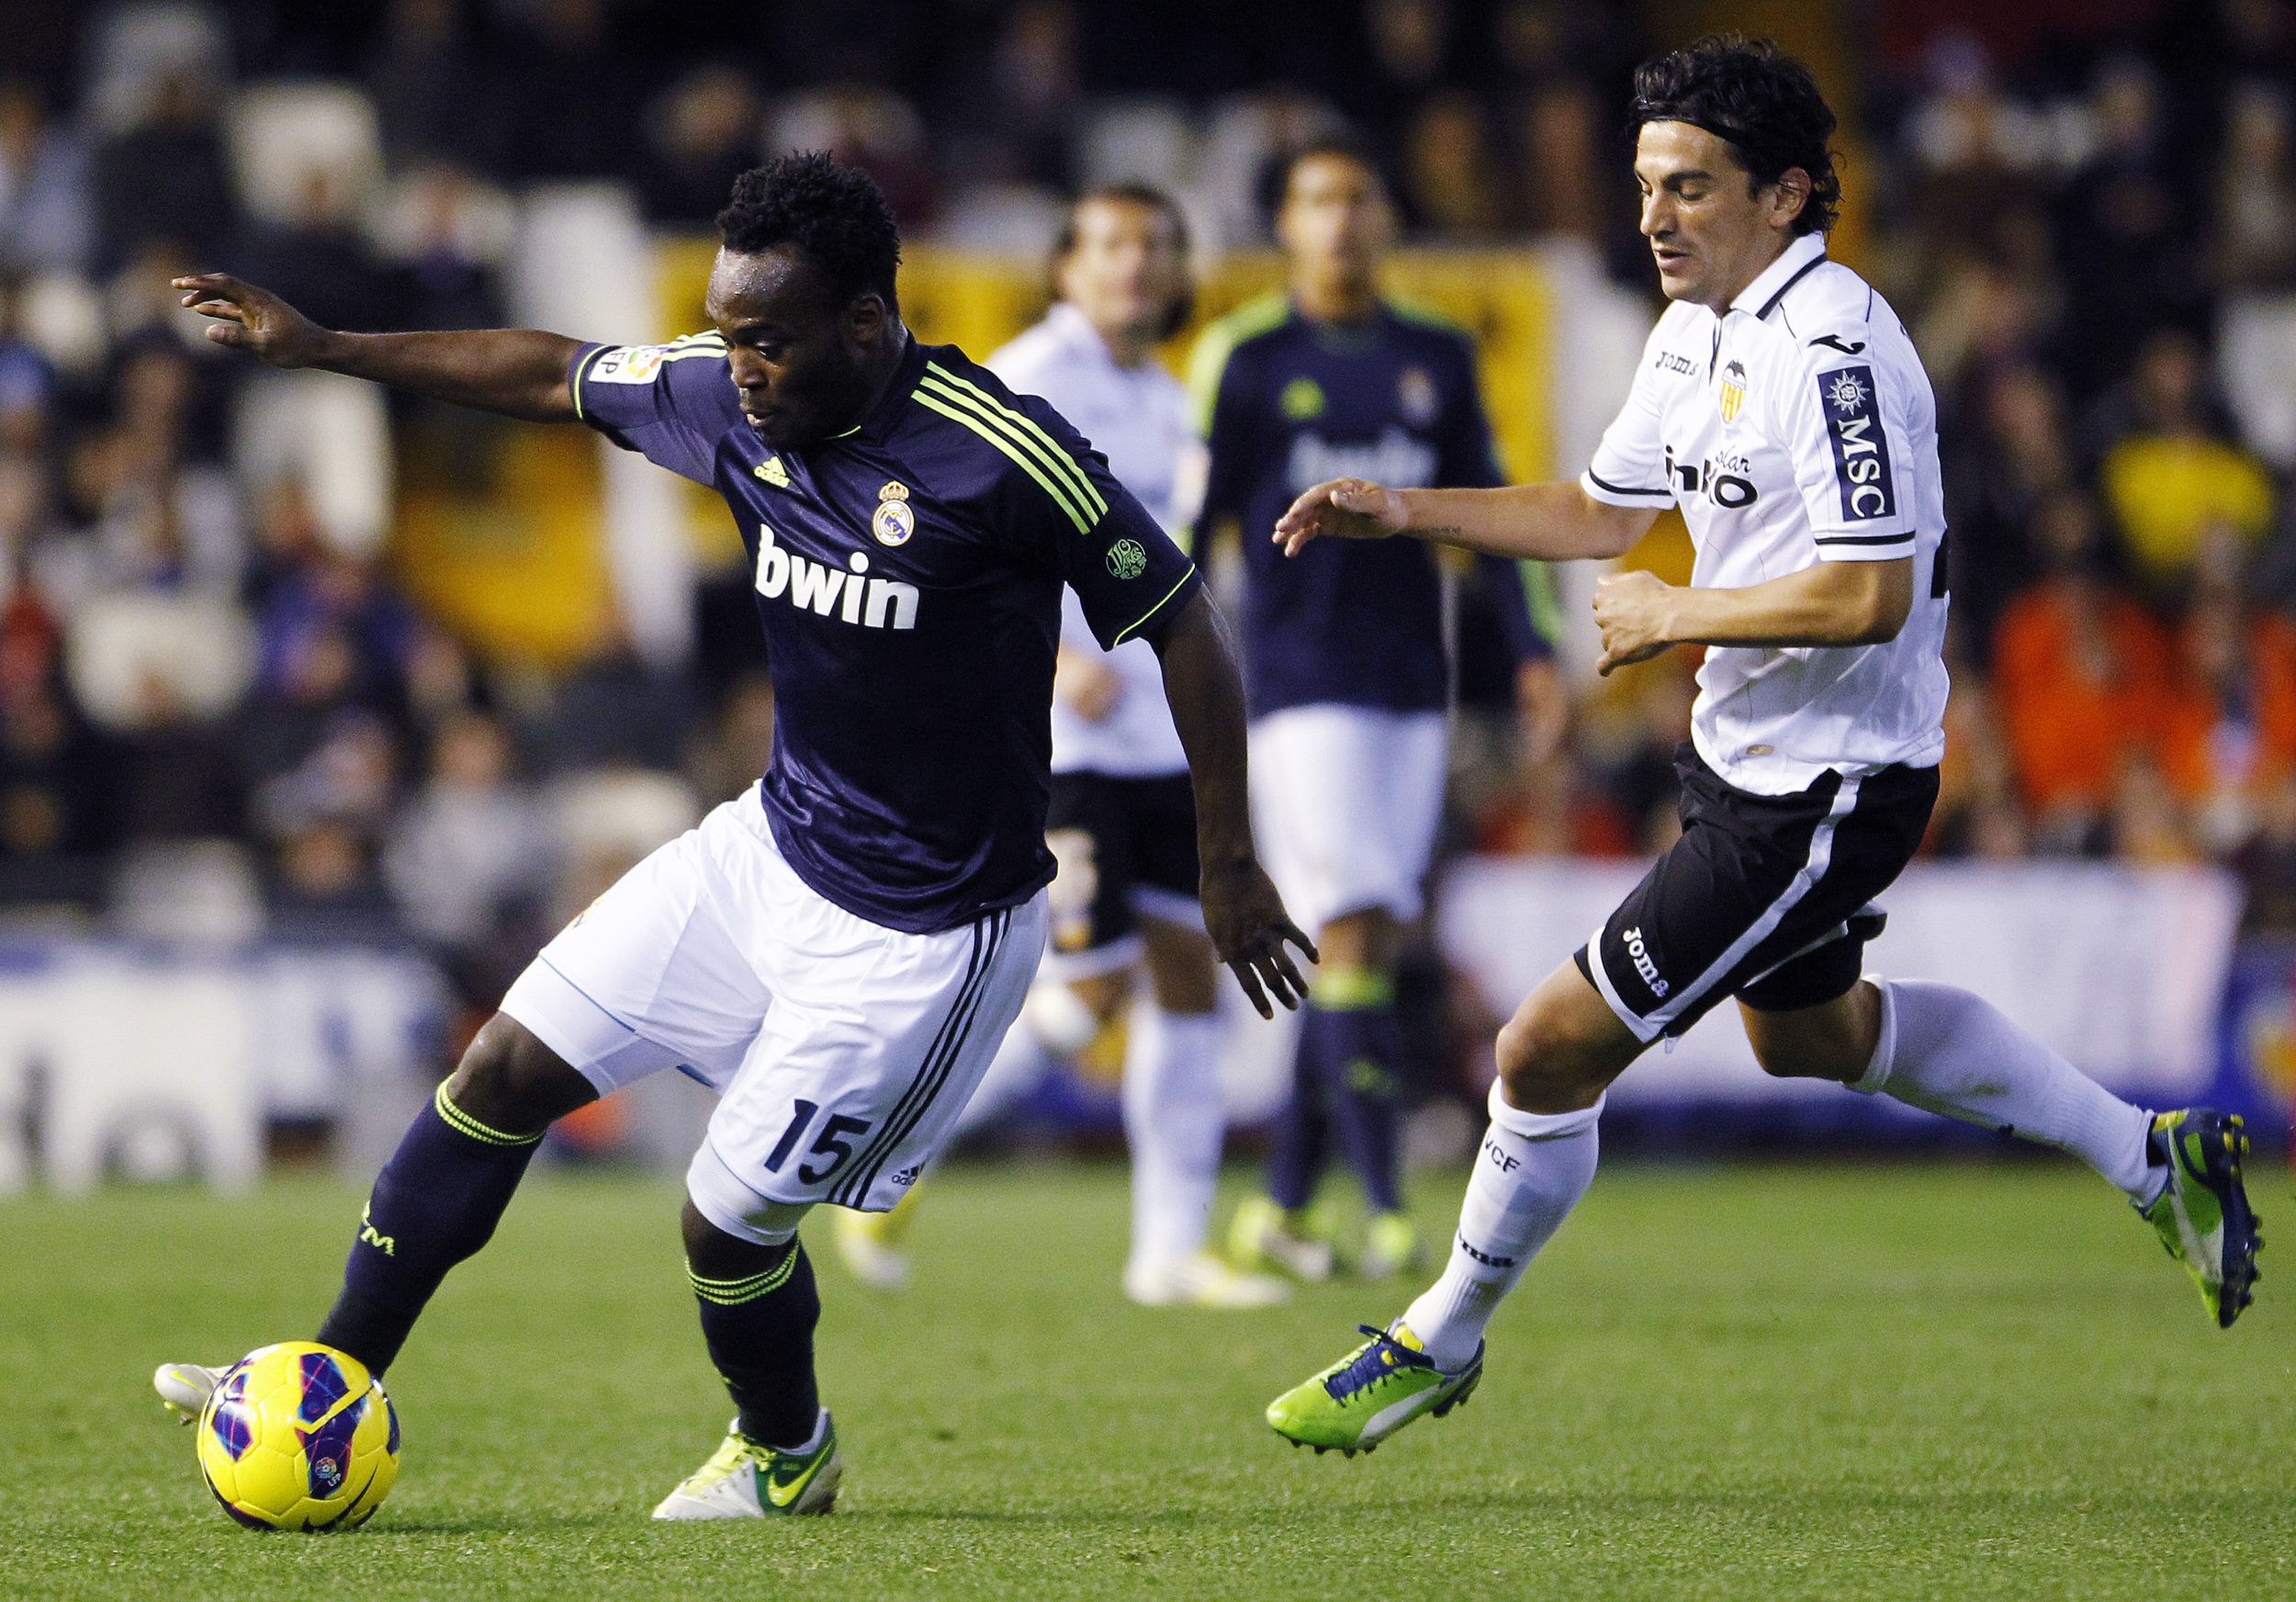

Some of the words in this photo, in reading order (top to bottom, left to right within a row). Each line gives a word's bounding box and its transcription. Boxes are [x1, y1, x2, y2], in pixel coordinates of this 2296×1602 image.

[1838, 414, 1885, 518] MSC
[755, 523, 919, 630] bwin
[1623, 926, 1669, 998] Joma
[764, 1099, 872, 1185] 15
[1484, 1132, 1521, 1173] VCF
